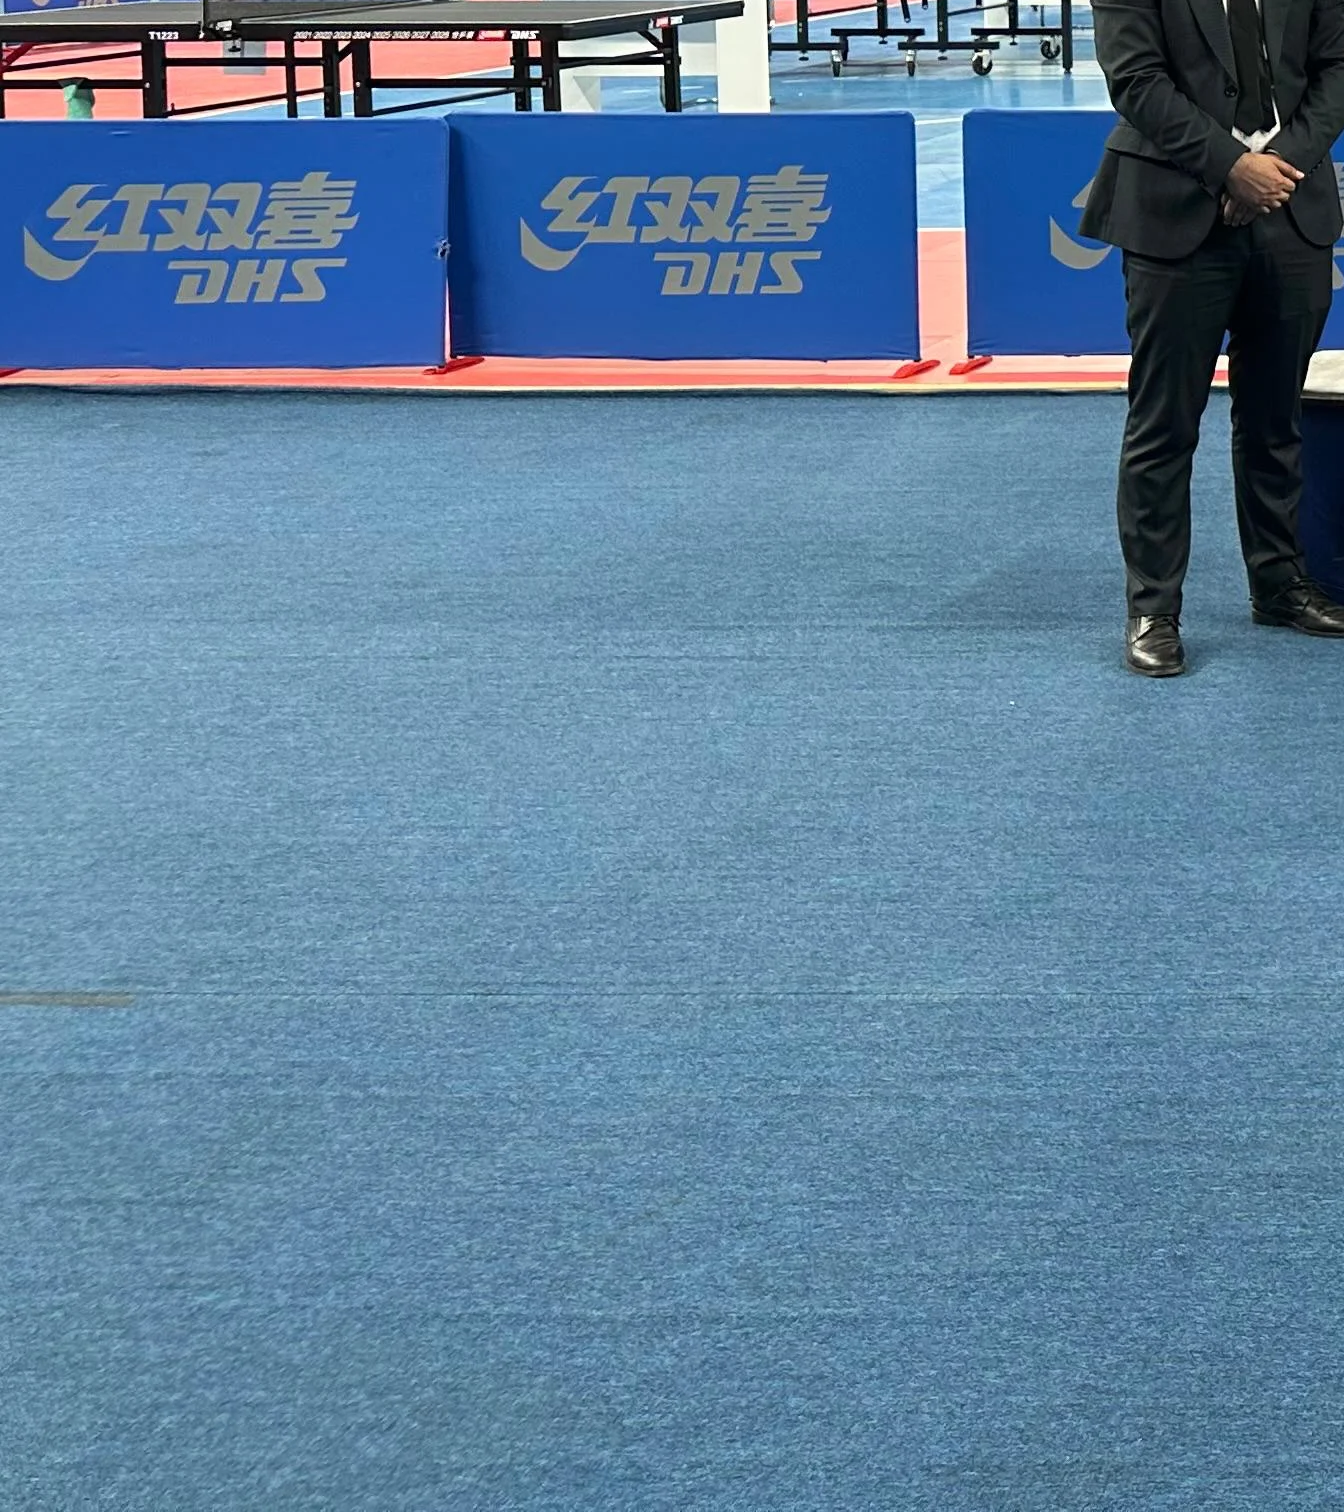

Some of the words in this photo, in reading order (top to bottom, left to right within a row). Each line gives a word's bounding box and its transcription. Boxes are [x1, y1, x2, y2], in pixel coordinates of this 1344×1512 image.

[148, 31, 179, 40] T1223
[510, 30, 540, 40] DHS
[24, 171, 360, 281] 红双喜
[520, 165, 833, 271] 红双喜
[167, 257, 348, 304] DHS
[652, 250, 822, 296] DHS
